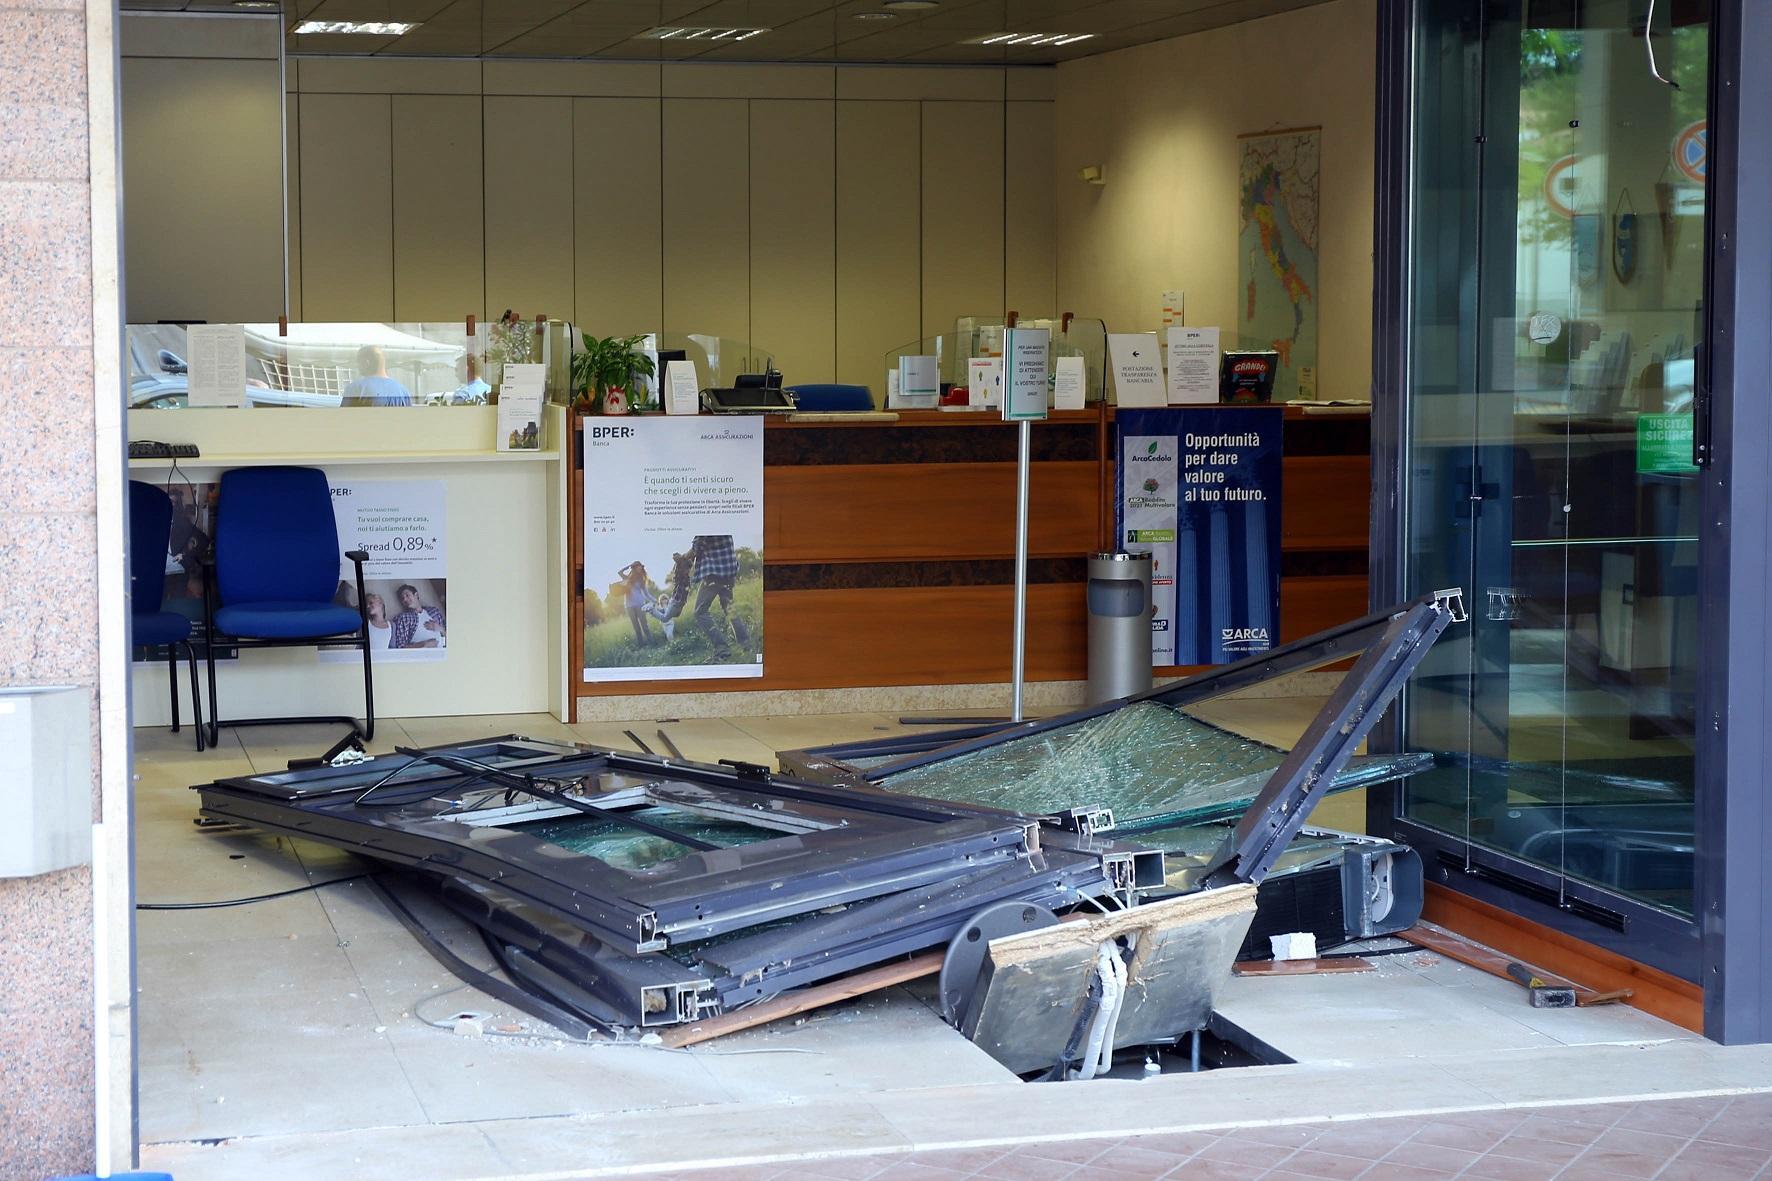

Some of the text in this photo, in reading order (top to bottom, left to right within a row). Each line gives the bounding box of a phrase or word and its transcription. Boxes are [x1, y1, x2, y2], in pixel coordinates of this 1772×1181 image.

[1650, 418, 1688, 430] USCITA
[592, 427, 634, 438] BPER:
[1186, 432, 1260, 450] Opportunità
[1186, 451, 1238, 468] per dare
[651, 476, 680, 486] quando
[1185, 469, 1224, 483] valore
[330, 488, 352, 496] PER:
[644, 486, 658, 495] che
[660, 486, 681, 496] scegli
[684, 486, 690, 494] di
[724, 486, 748, 495] pieno.
[1185, 487, 1266, 501] al tuo futuro.
[358, 542, 390, 552] Spread
[1234, 628, 1268, 639] ARCA
